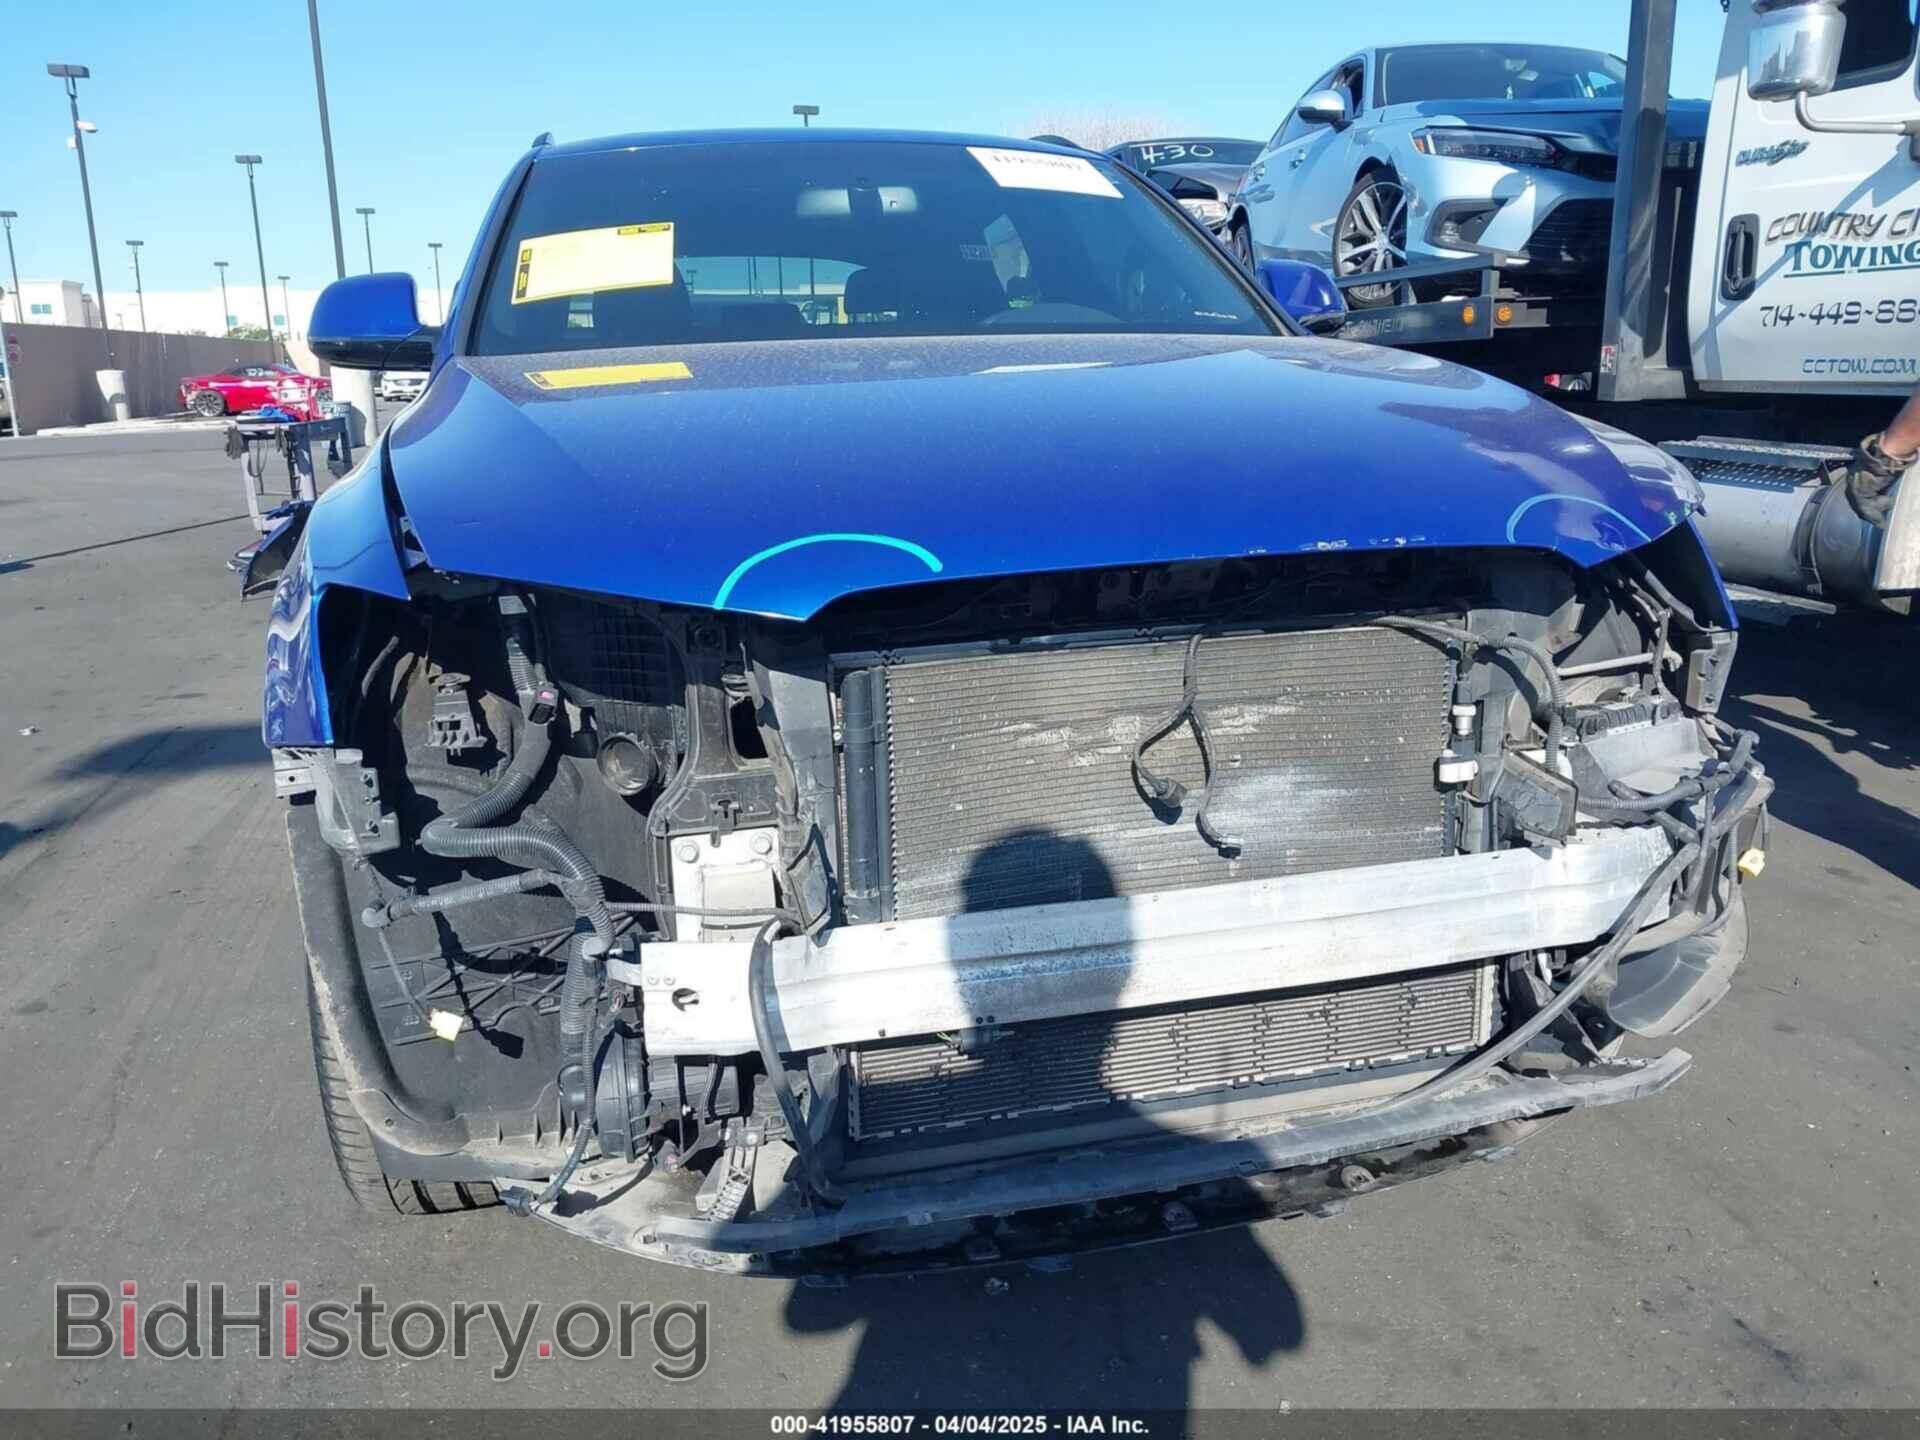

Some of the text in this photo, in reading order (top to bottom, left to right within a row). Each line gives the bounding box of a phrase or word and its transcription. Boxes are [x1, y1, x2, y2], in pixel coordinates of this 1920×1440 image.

[1765, 211, 1888, 244] COUNTRY
[1760, 298, 1920, 328] 714-449-88
[1802, 358, 1917, 375] CCTOW.COM
